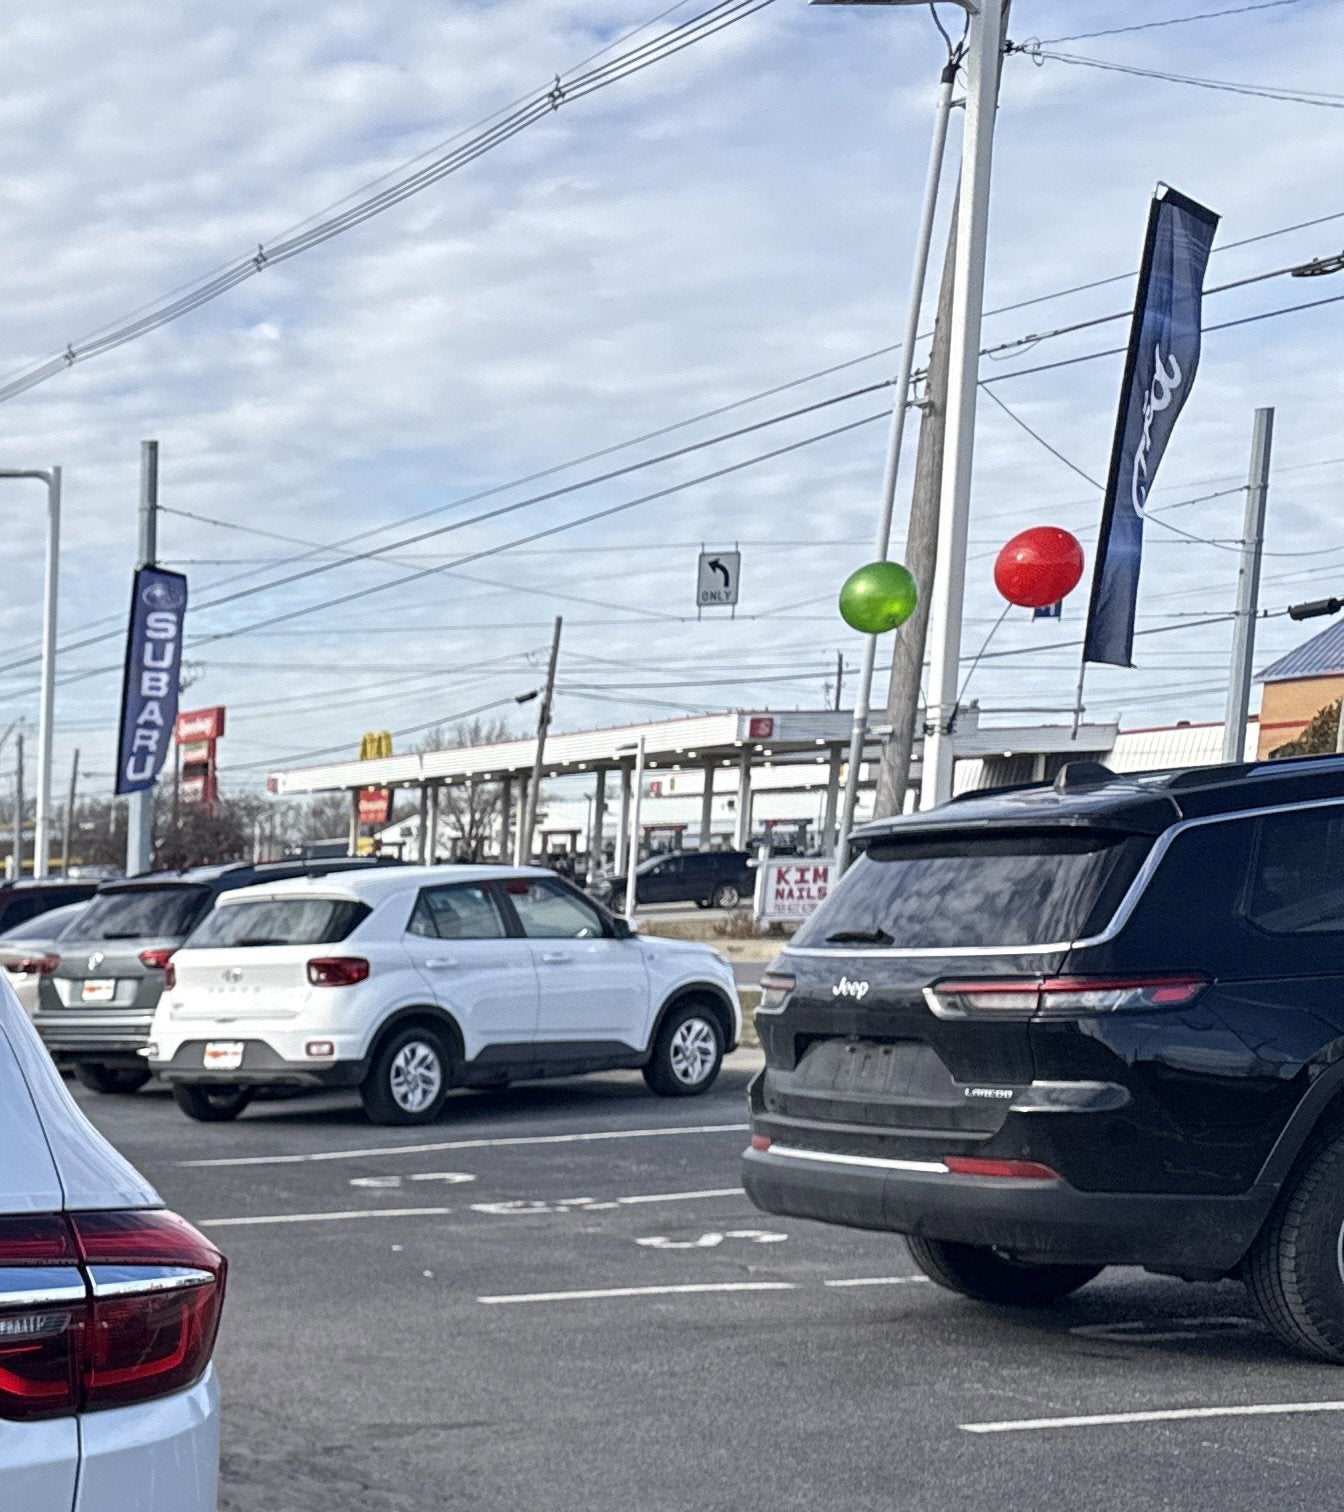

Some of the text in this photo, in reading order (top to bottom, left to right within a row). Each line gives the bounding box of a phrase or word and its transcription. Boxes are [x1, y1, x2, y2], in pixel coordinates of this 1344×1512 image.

[701, 590, 731, 602] ONLY
[125, 611, 178, 782] SUBARU
[776, 866, 829, 885] KIM
[775, 886, 828, 900] NAILS
[832, 976, 869, 1000] Jeep
